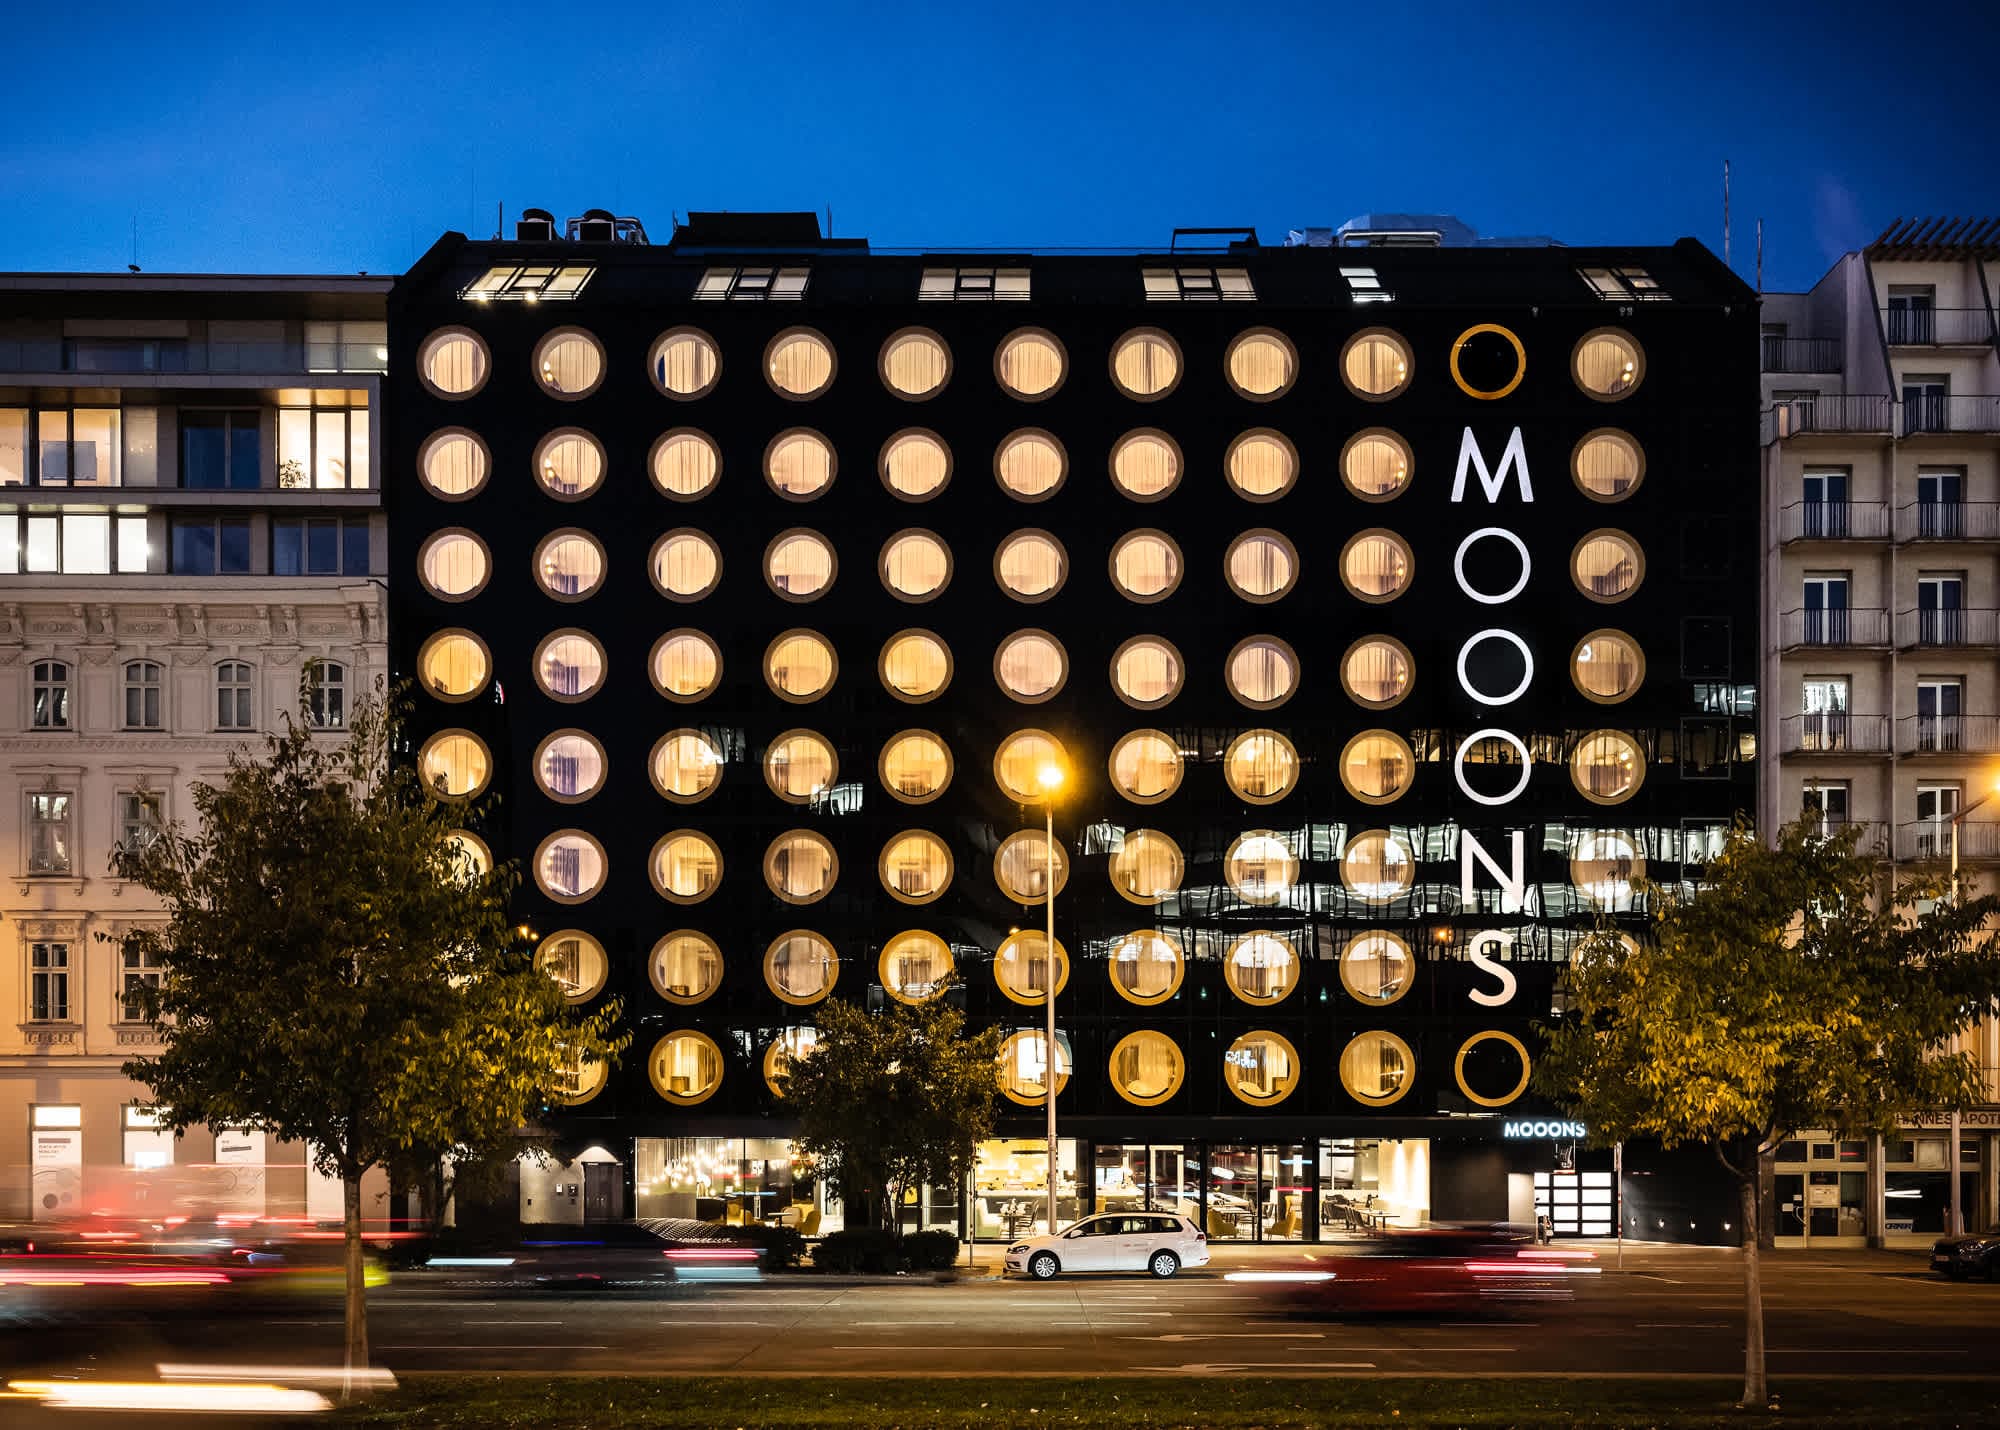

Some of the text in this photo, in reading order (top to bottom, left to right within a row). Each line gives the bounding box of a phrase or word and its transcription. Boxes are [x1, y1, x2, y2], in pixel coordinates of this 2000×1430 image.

[1451, 426, 1533, 1007] MOOONS
[1960, 1112, 2000, 1125] APOT
[1504, 1121, 1586, 1138] MOOONS
